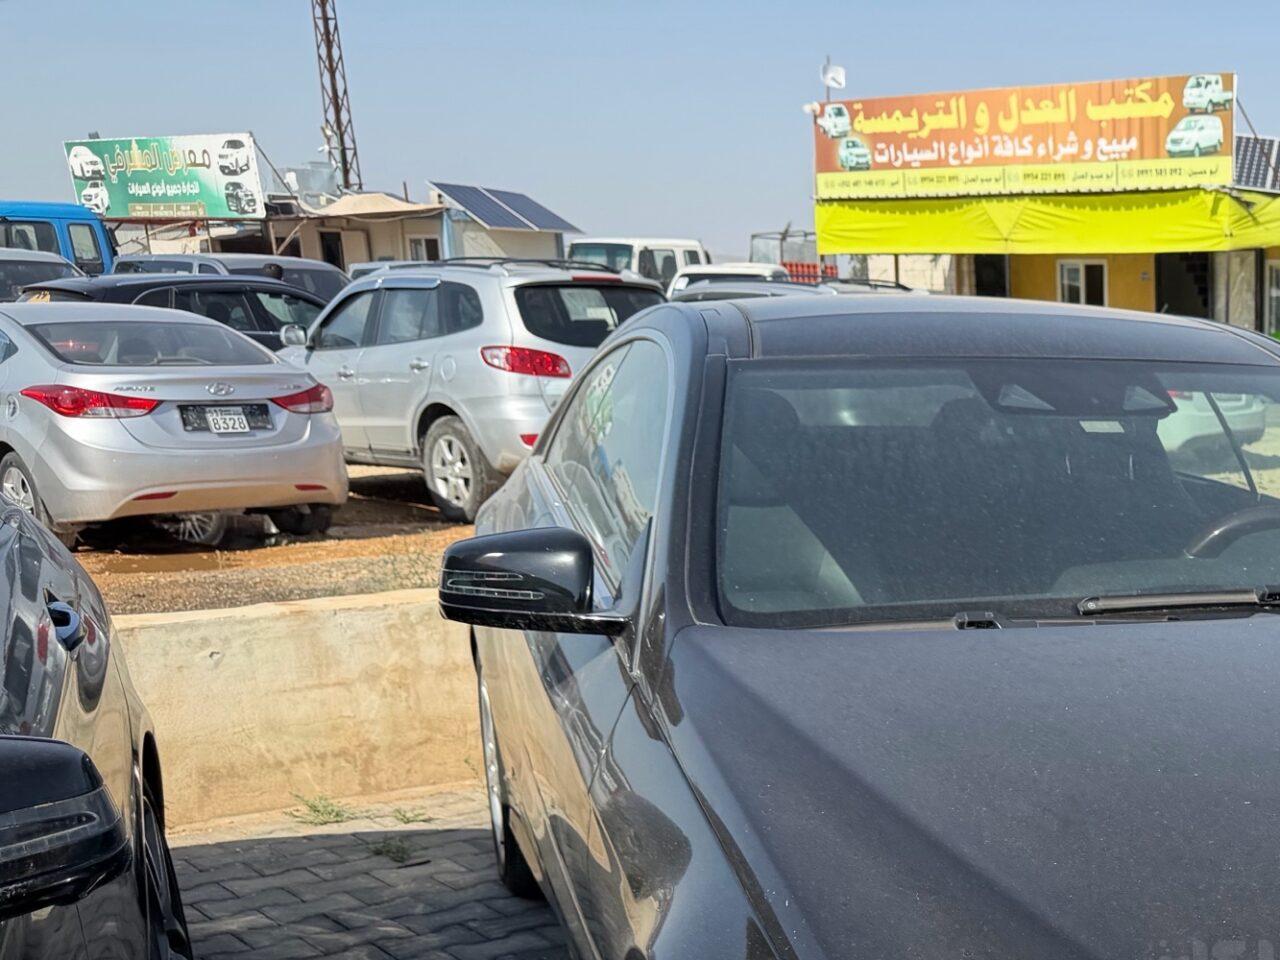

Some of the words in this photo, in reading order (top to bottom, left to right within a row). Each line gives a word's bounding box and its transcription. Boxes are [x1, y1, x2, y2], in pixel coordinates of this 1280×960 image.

[853, 96, 967, 139] التريمسة
[973, 101, 990, 135] و
[998, 87, 1077, 136] العدل
[1086, 81, 1175, 128] مكتب
[874, 140, 946, 168] السيارات
[991, 133, 1034, 158] كافة
[1037, 130, 1079, 161] شراء
[1079, 136, 1093, 160] و
[1096, 134, 1139, 161] مبيع
[162, 148, 211, 176] معرض
[212, 417, 246, 430] 8328
